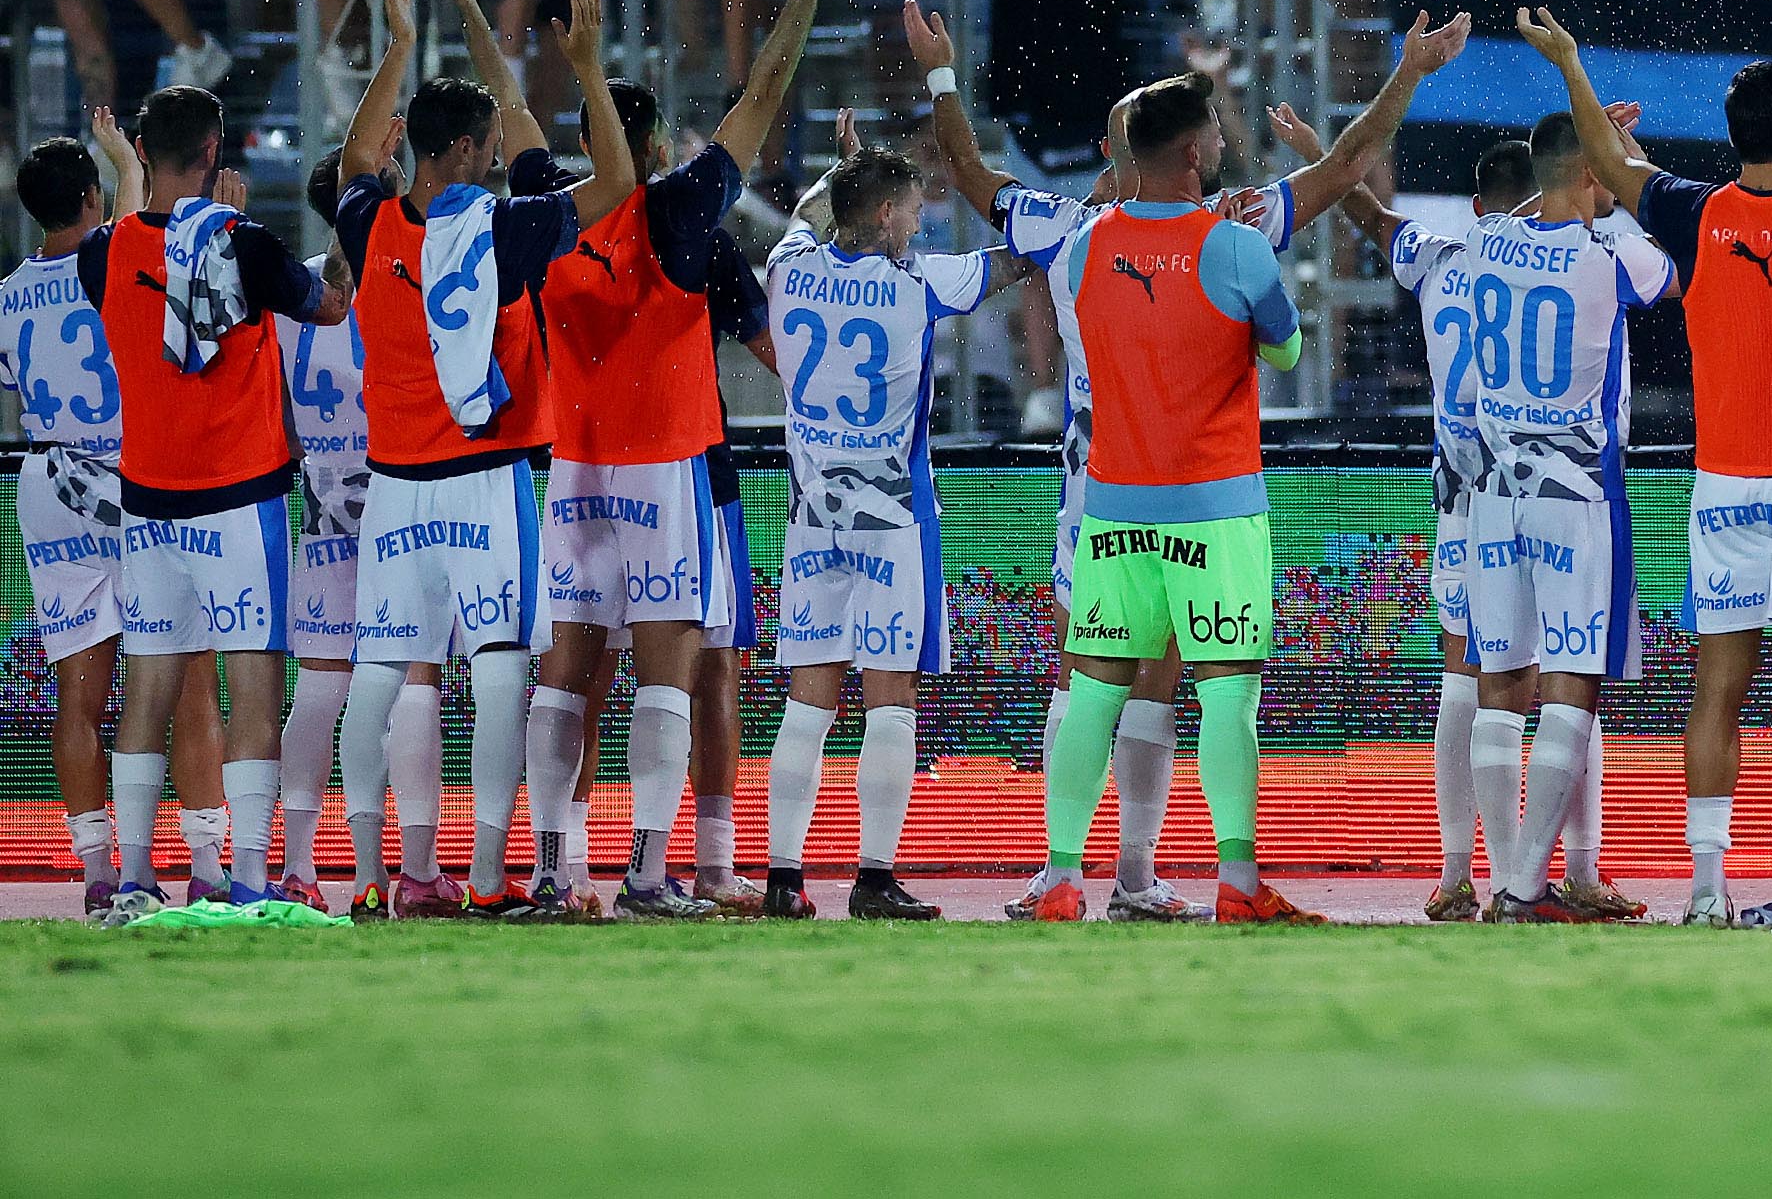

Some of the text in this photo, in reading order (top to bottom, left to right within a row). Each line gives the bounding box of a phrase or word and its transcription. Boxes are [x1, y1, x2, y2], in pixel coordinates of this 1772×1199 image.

[1480, 235, 1579, 274] YOUSSEF
[785, 268, 896, 307] BRANDON
[1473, 273, 1575, 399] 80
[18, 308, 120, 430] 43
[783, 308, 889, 428] 23
[1526, 401, 1593, 426] island
[374, 519, 490, 563] PETROINA
[1089, 528, 1208, 569] PETROINA
[626, 556, 699, 603] bbf:
[1188, 599, 1260, 646] bbf:
[1541, 610, 1605, 656] bbf
